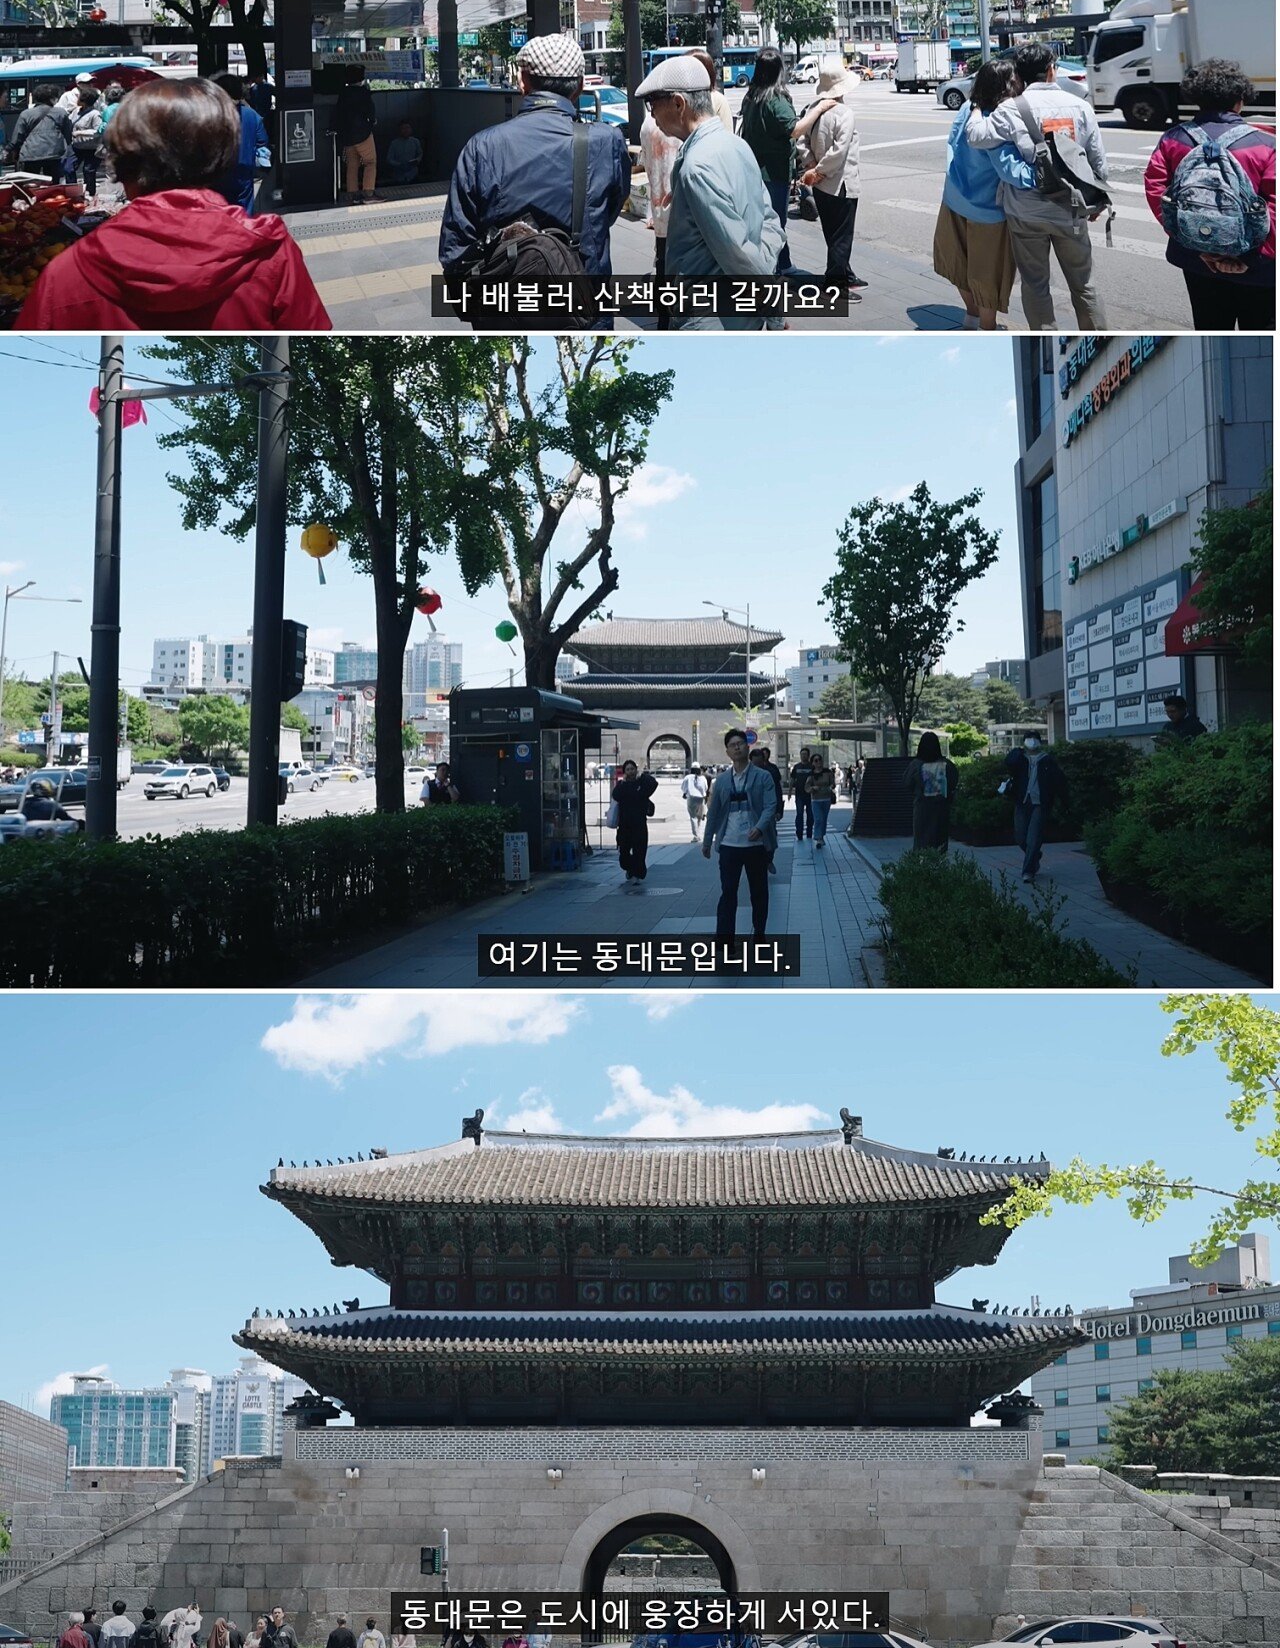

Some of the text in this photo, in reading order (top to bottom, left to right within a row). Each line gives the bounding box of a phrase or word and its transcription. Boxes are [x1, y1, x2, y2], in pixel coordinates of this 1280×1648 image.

[1083, 1315, 1130, 1341] Hotel
[1136, 1304, 1261, 1335] Dongdaemun
[242, 1401, 263, 1409] CASTLE
